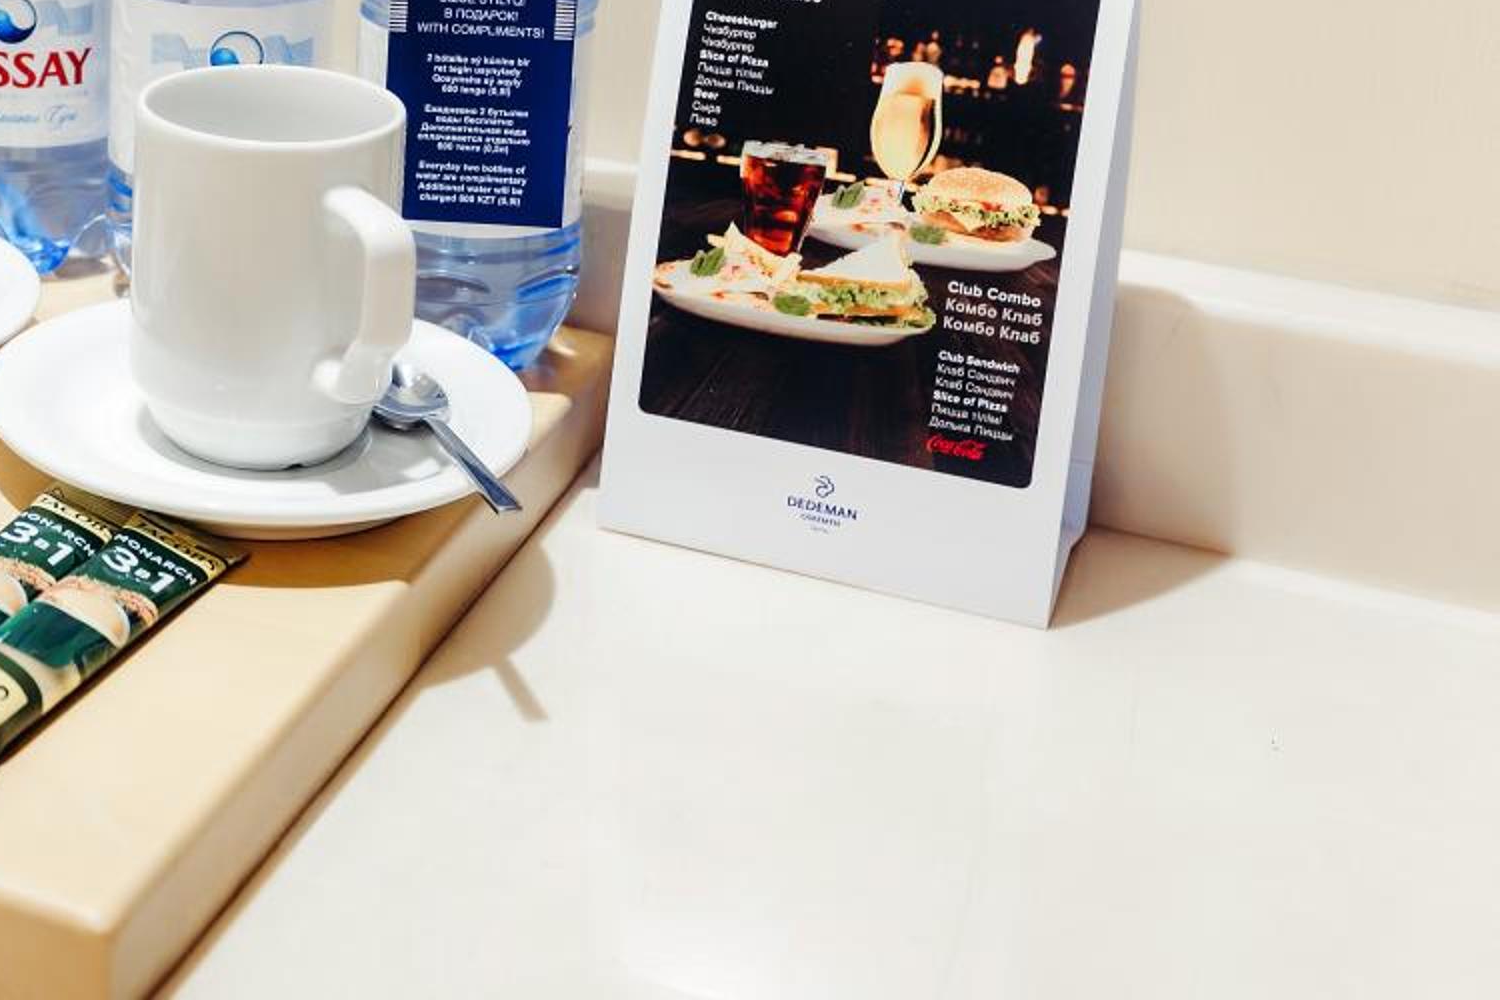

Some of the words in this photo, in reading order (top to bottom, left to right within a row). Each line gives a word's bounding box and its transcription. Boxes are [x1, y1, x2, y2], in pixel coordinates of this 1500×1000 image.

[455, 8, 519, 21] ПОДАРОК!
[705, 10, 779, 30] Cheeseburger
[417, 22, 449, 34] WITH
[451, 23, 545, 39] COMPLIMENTS!
[700, 49, 725, 61] Slice
[727, 54, 739, 63] of
[741, 55, 769, 68] Pizza
[694, 87, 719, 100] Beer
[418, 160, 460, 172] Everyday
[482, 164, 513, 174] bottles
[515, 165, 526, 174] of
[477, 195, 496, 205] KZT
[947, 281, 982, 297] Club
[987, 287, 1041, 308] Combo
[945, 298, 997, 318] Комбо
[1002, 307, 1043, 326] Клаб
[943, 316, 995, 336] Комбо
[1000, 325, 1041, 344] Клаб
[938, 350, 964, 363] Club
[966, 355, 1021, 374] Sandwich
[933, 390, 960, 403] Slice
[963, 396, 975, 406] of
[978, 400, 1008, 413] Pizza
[787, 496, 857, 520] DEDEMAN
[113, 532, 198, 586] MONARCH
